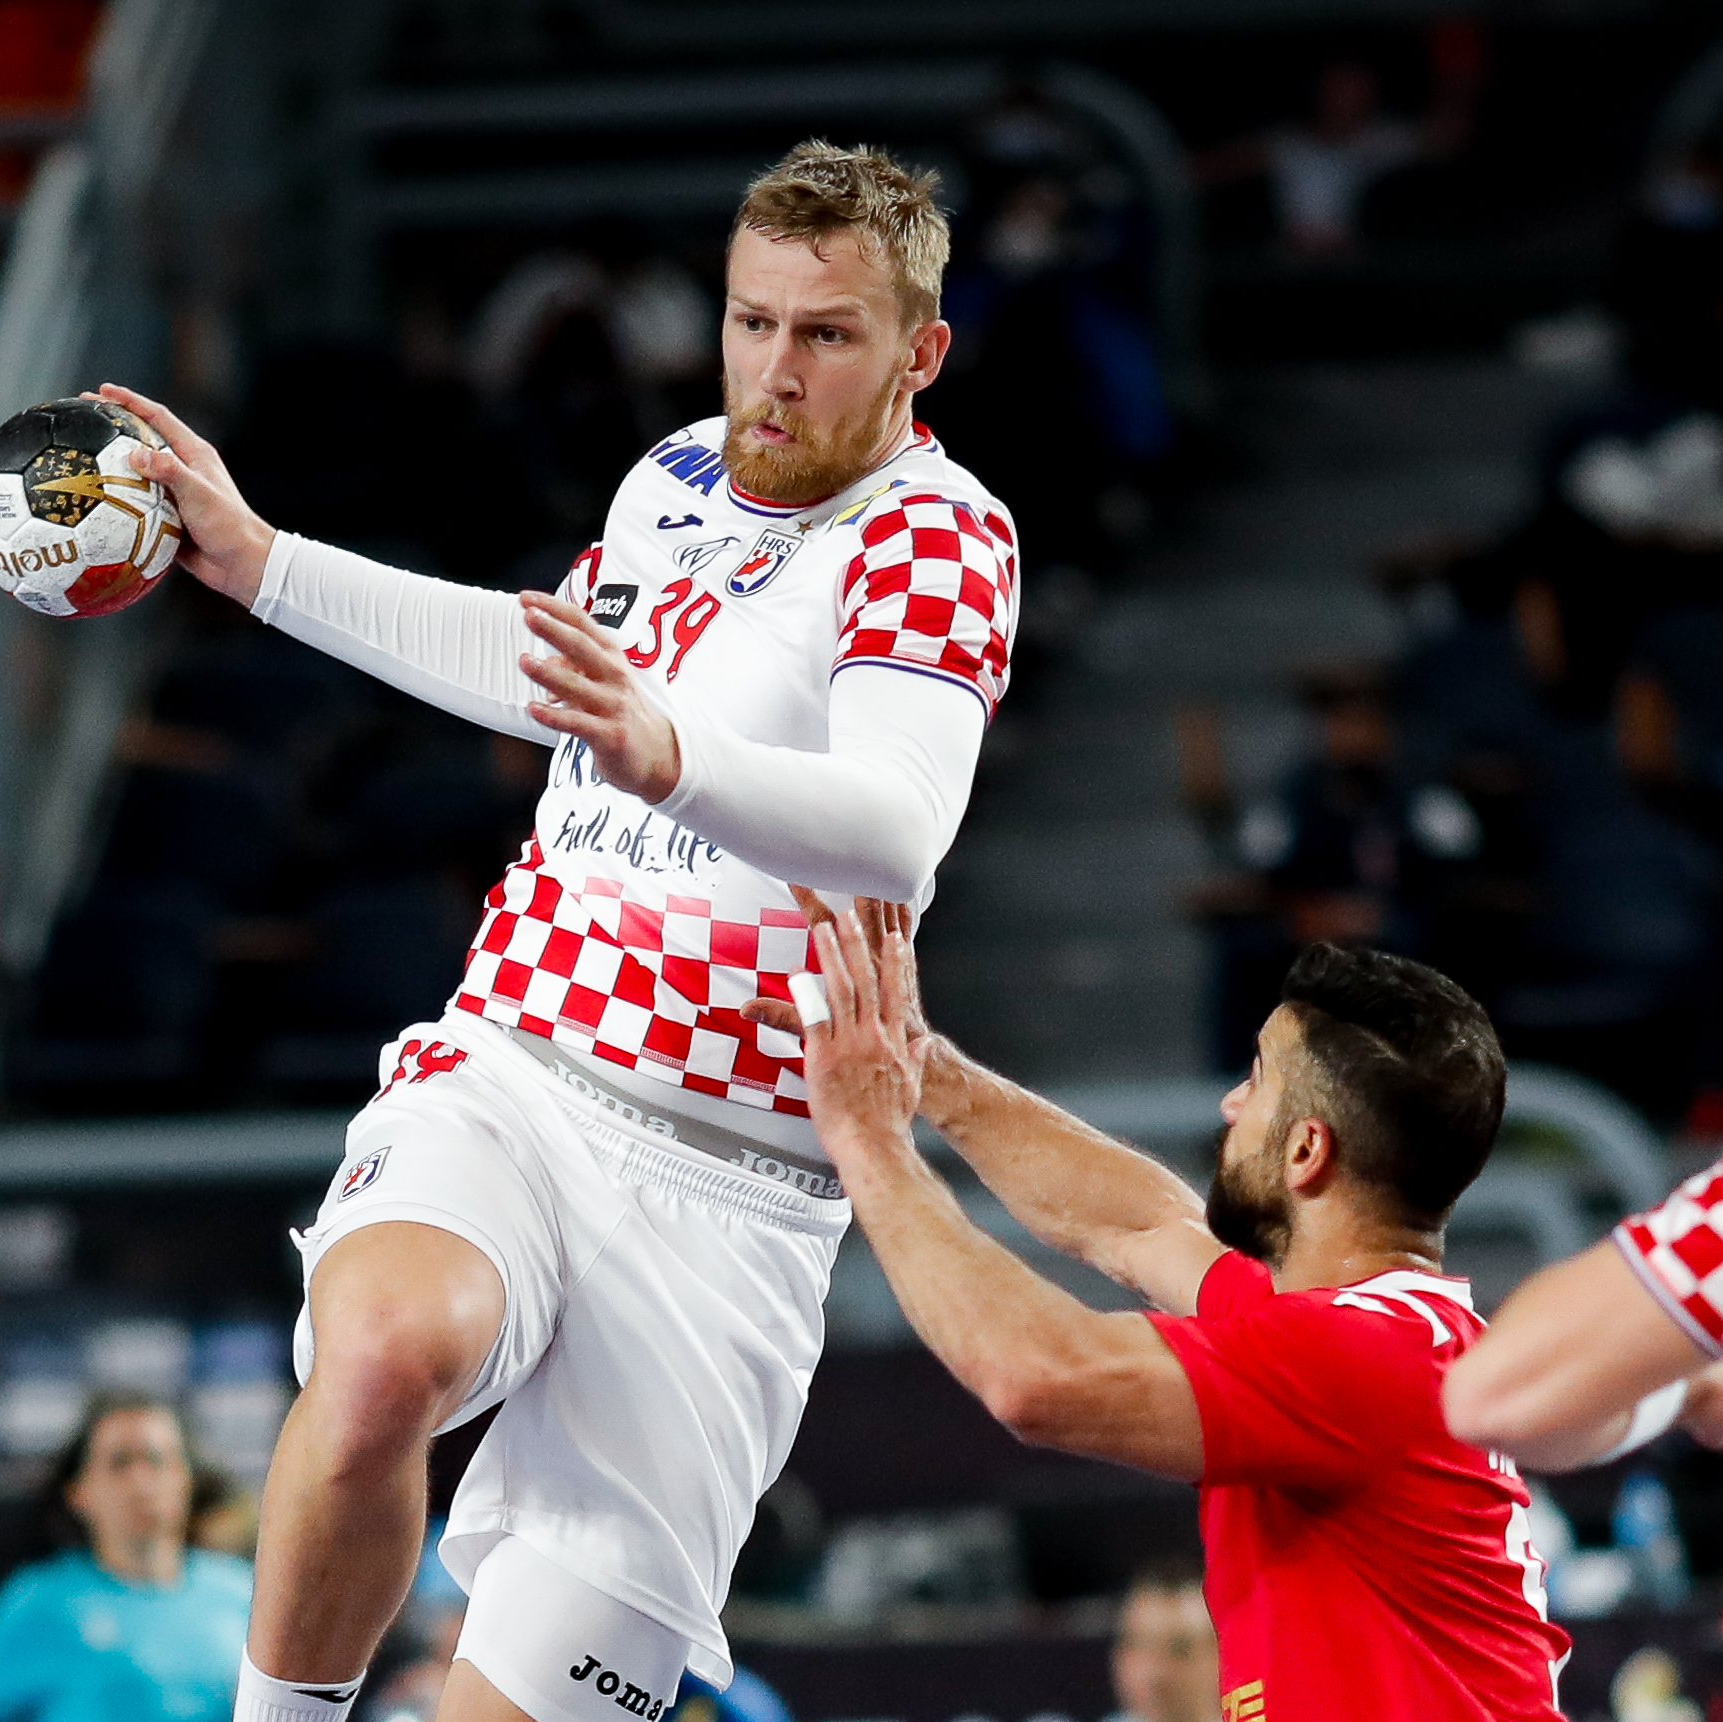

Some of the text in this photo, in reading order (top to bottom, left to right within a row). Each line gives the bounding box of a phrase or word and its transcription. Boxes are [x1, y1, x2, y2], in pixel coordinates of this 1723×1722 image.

[757, 535, 797, 556] HRS
[623, 577, 722, 685] 39
[570, 1655, 663, 1722] Joma
